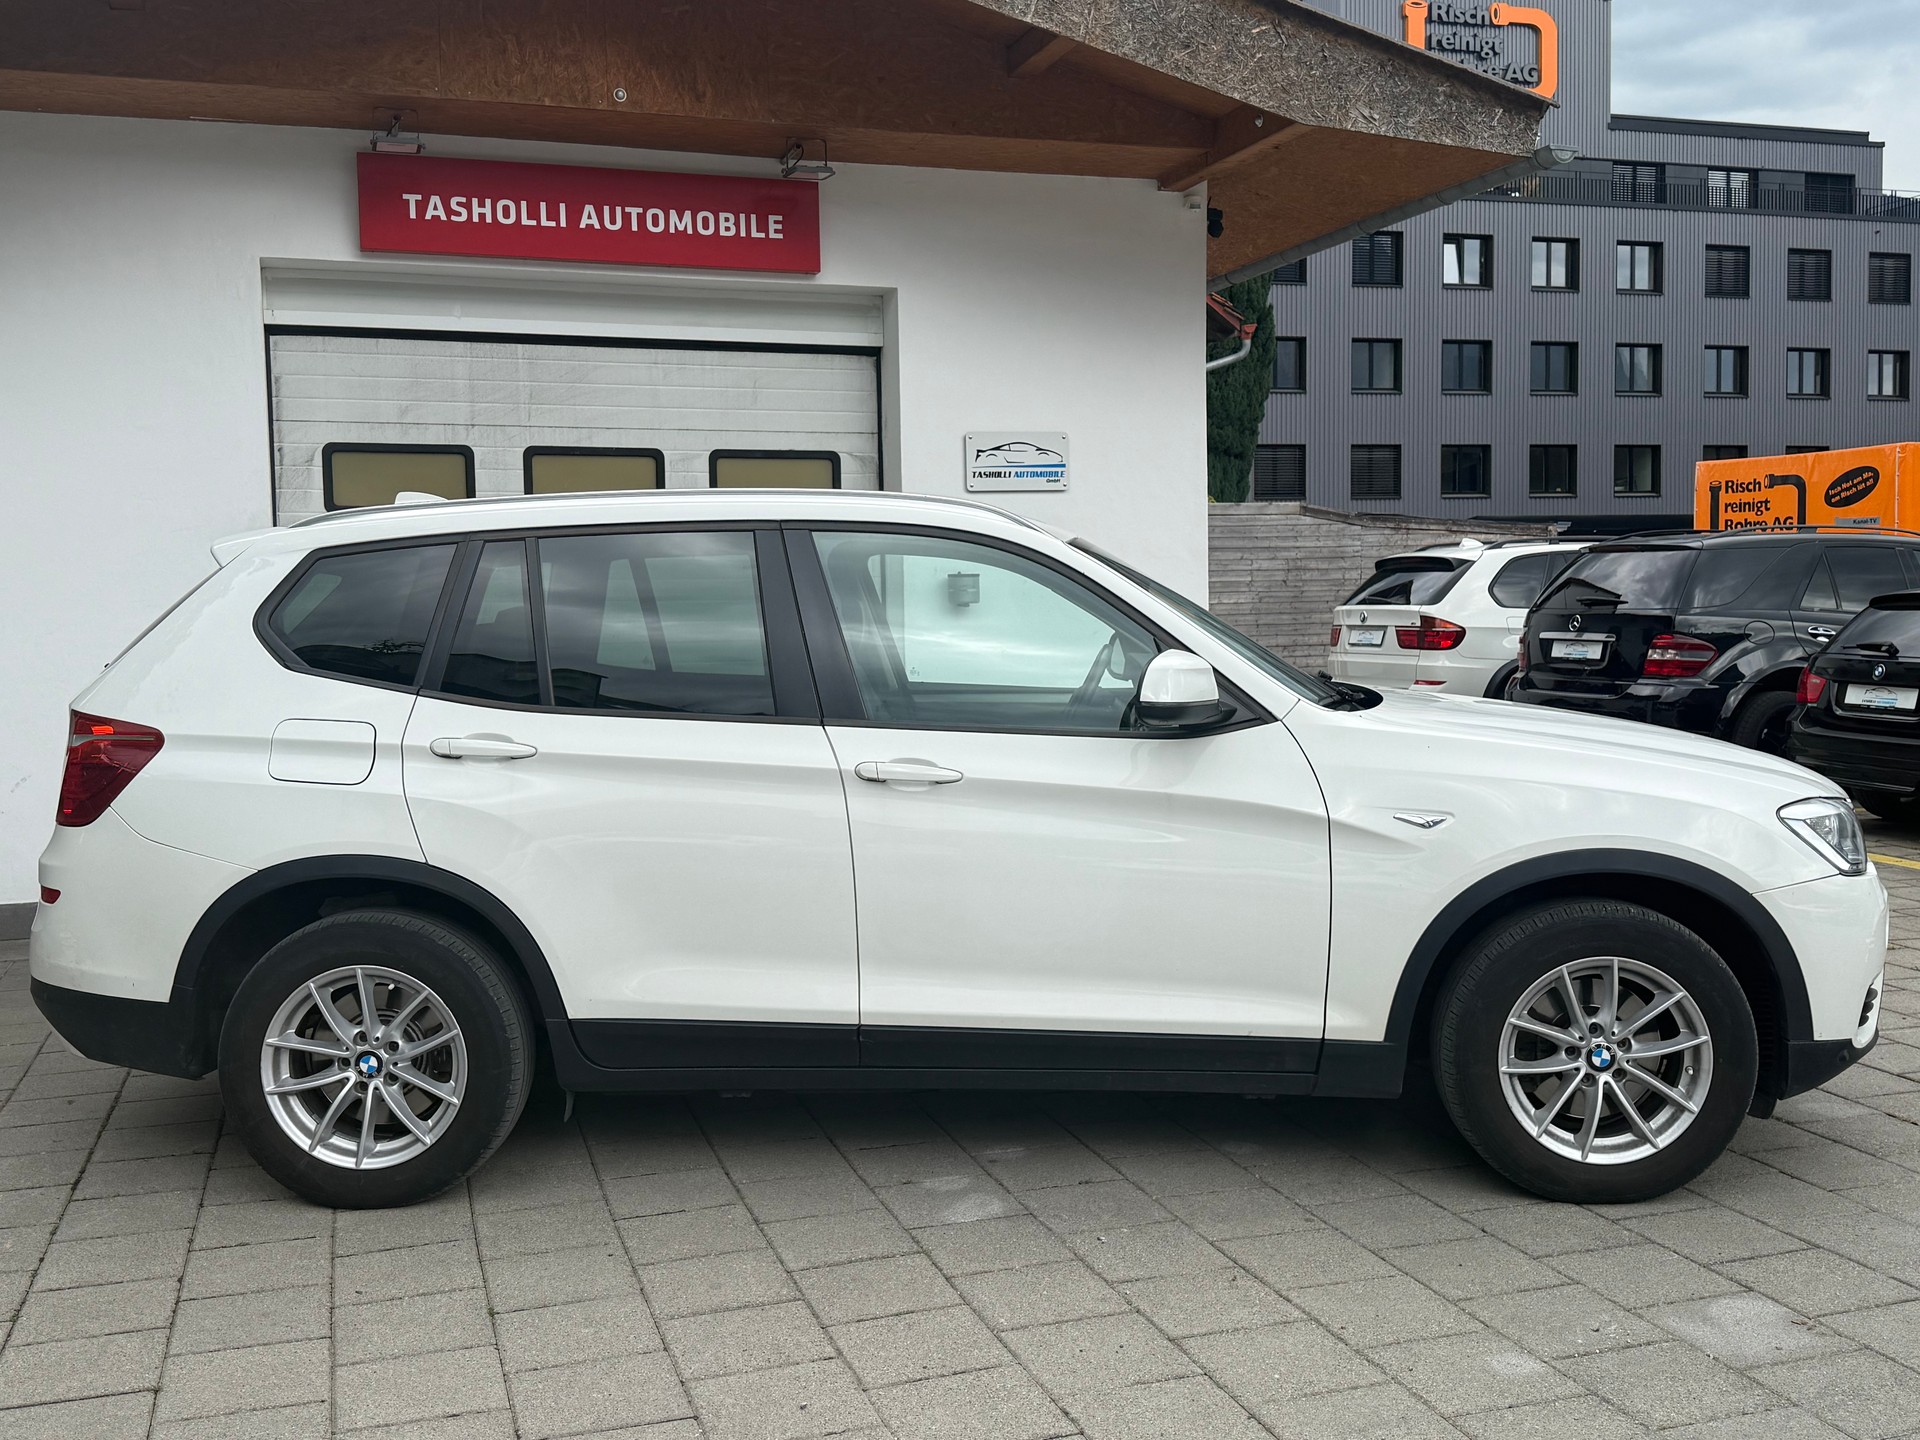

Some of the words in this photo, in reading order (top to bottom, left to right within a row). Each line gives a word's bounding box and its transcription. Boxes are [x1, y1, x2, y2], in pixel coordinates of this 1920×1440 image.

[1431, 2, 1490, 25] Risch
[1431, 31, 1503, 58] reinigt
[1505, 62, 1538, 82] AG
[402, 193, 567, 228] TASHOLLI
[579, 203, 784, 239] AUTOMOBILE
[1724, 479, 1762, 494] Risch
[1724, 498, 1771, 516] reinigt
[1772, 516, 1794, 532] AG
